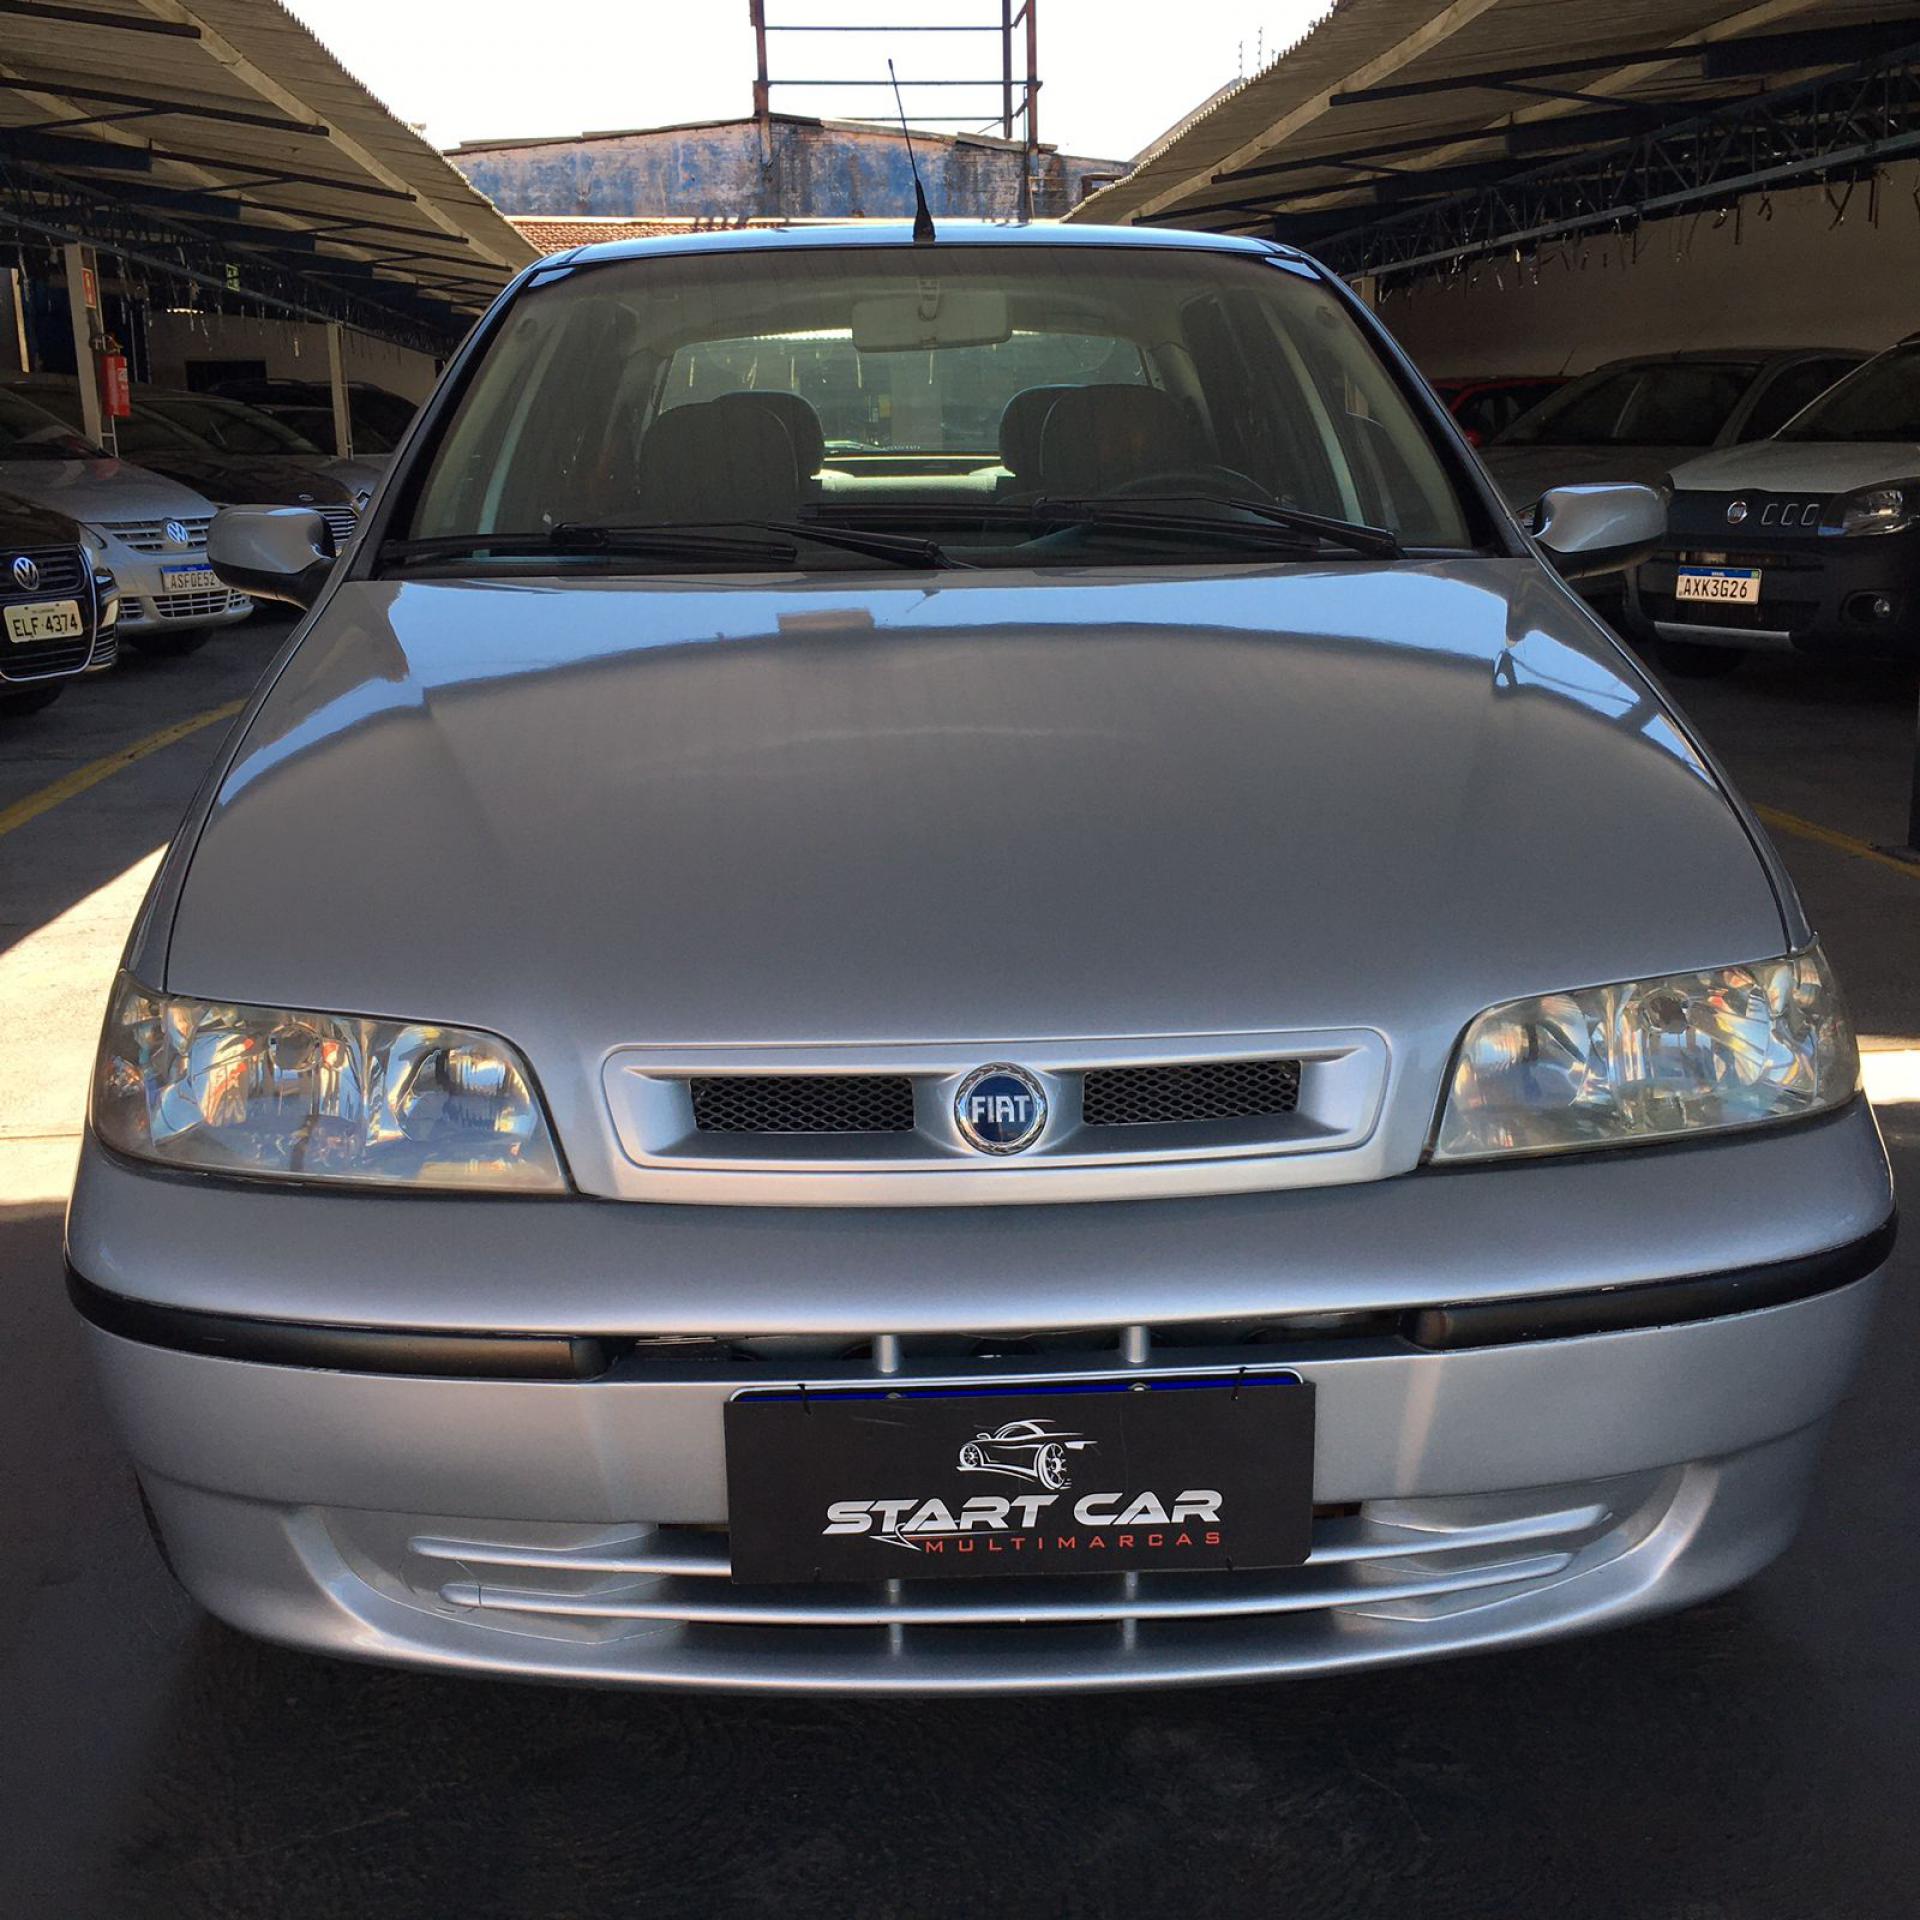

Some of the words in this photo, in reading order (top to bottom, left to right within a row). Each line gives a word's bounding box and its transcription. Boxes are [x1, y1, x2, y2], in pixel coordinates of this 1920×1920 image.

[1683, 578, 1748, 598] AXK3G26
[972, 1095, 1030, 1123] FIAT
[822, 1494, 1059, 1535] START
[1073, 1489, 1223, 1526] CAR
[925, 1531, 1221, 1554] MULTIMARCAS
